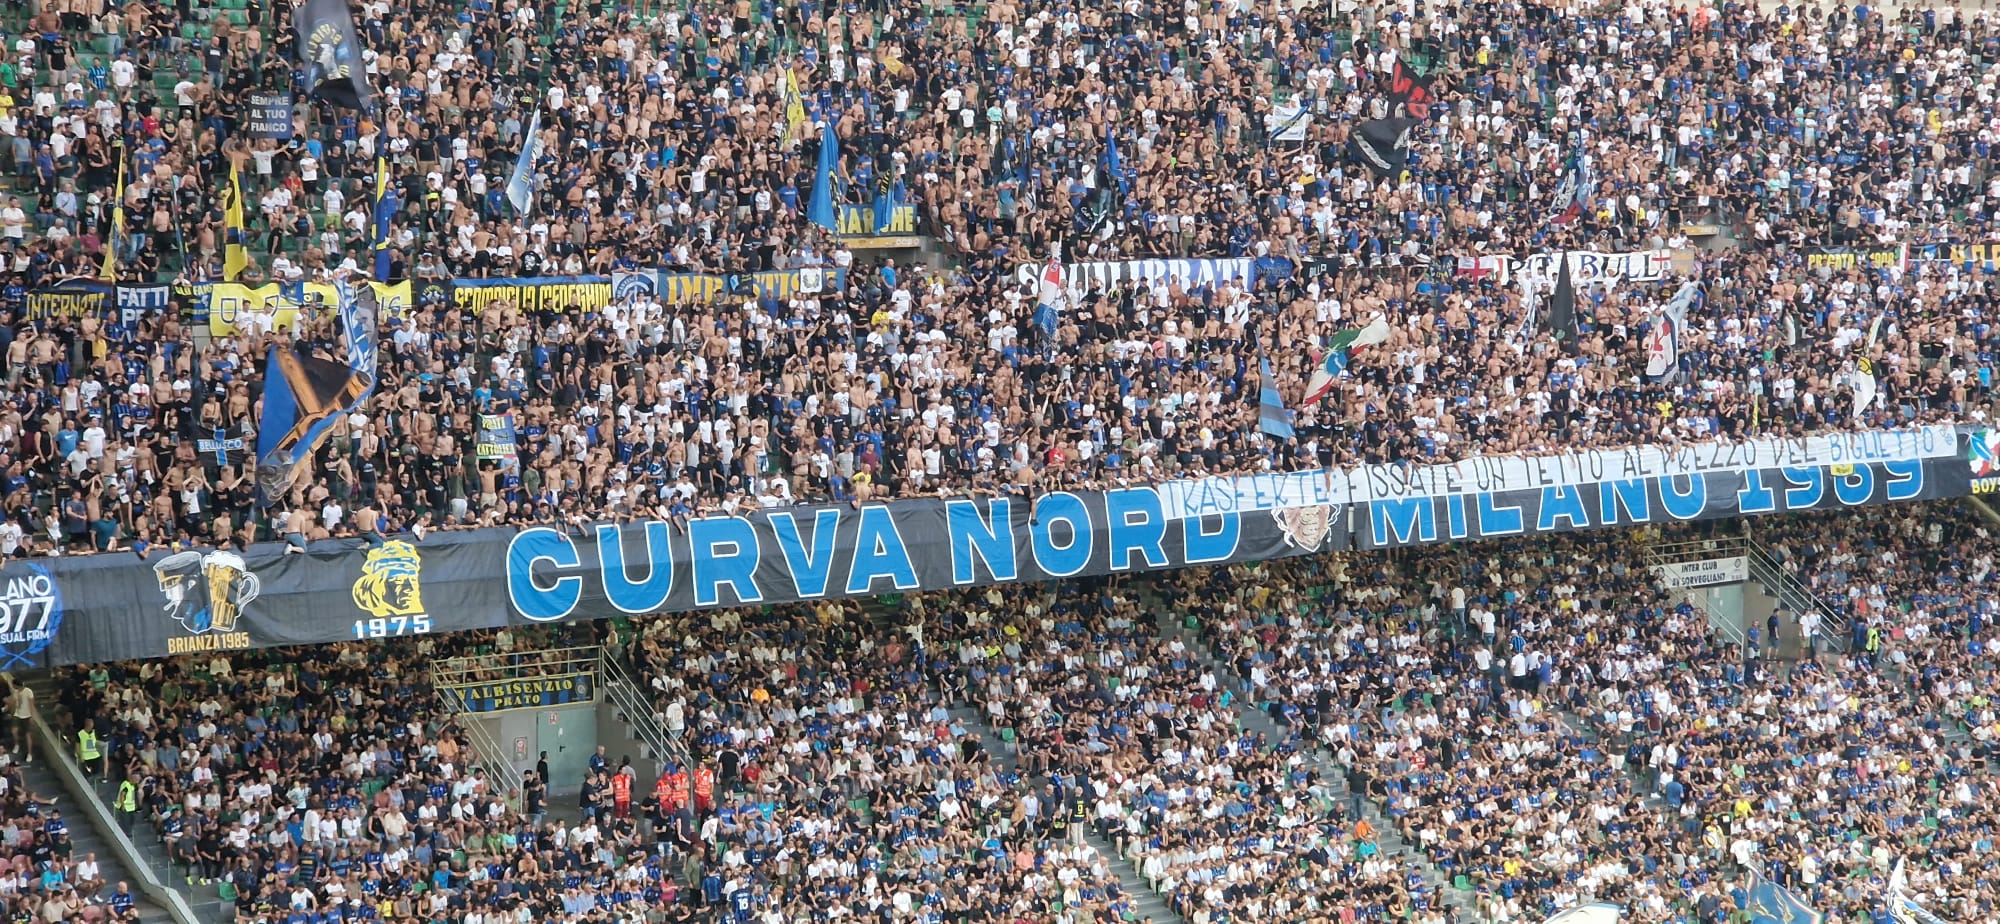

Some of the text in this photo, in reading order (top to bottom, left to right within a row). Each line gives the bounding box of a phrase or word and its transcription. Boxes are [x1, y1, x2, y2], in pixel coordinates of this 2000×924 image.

[251, 95, 288, 105] SEMPRE
[251, 109, 287, 118] AL TUO
[251, 122, 287, 132] FIANCO
[117, 286, 169, 307] FATTI
[1473, 457, 1506, 491] UN
[1623, 447, 1652, 478] AL
[1770, 436, 1817, 466] DEL
[1828, 427, 1934, 463] BIGLIETTO
[1971, 477, 2000, 494] BOY
[506, 504, 920, 621] CURVA
[945, 486, 1242, 585] NORD
[1368, 466, 1708, 546] MILANO
[1681, 560, 1718, 573] INTER CLUB
[354, 613, 432, 639] 1975
[26, 629, 51, 641] FIRM
[168, 631, 249, 654] BRIANZA 1985
[456, 679, 573, 701] VALBISENZIO
[494, 694, 541, 708] PRATO
[738, 898, 749, 910] 16
